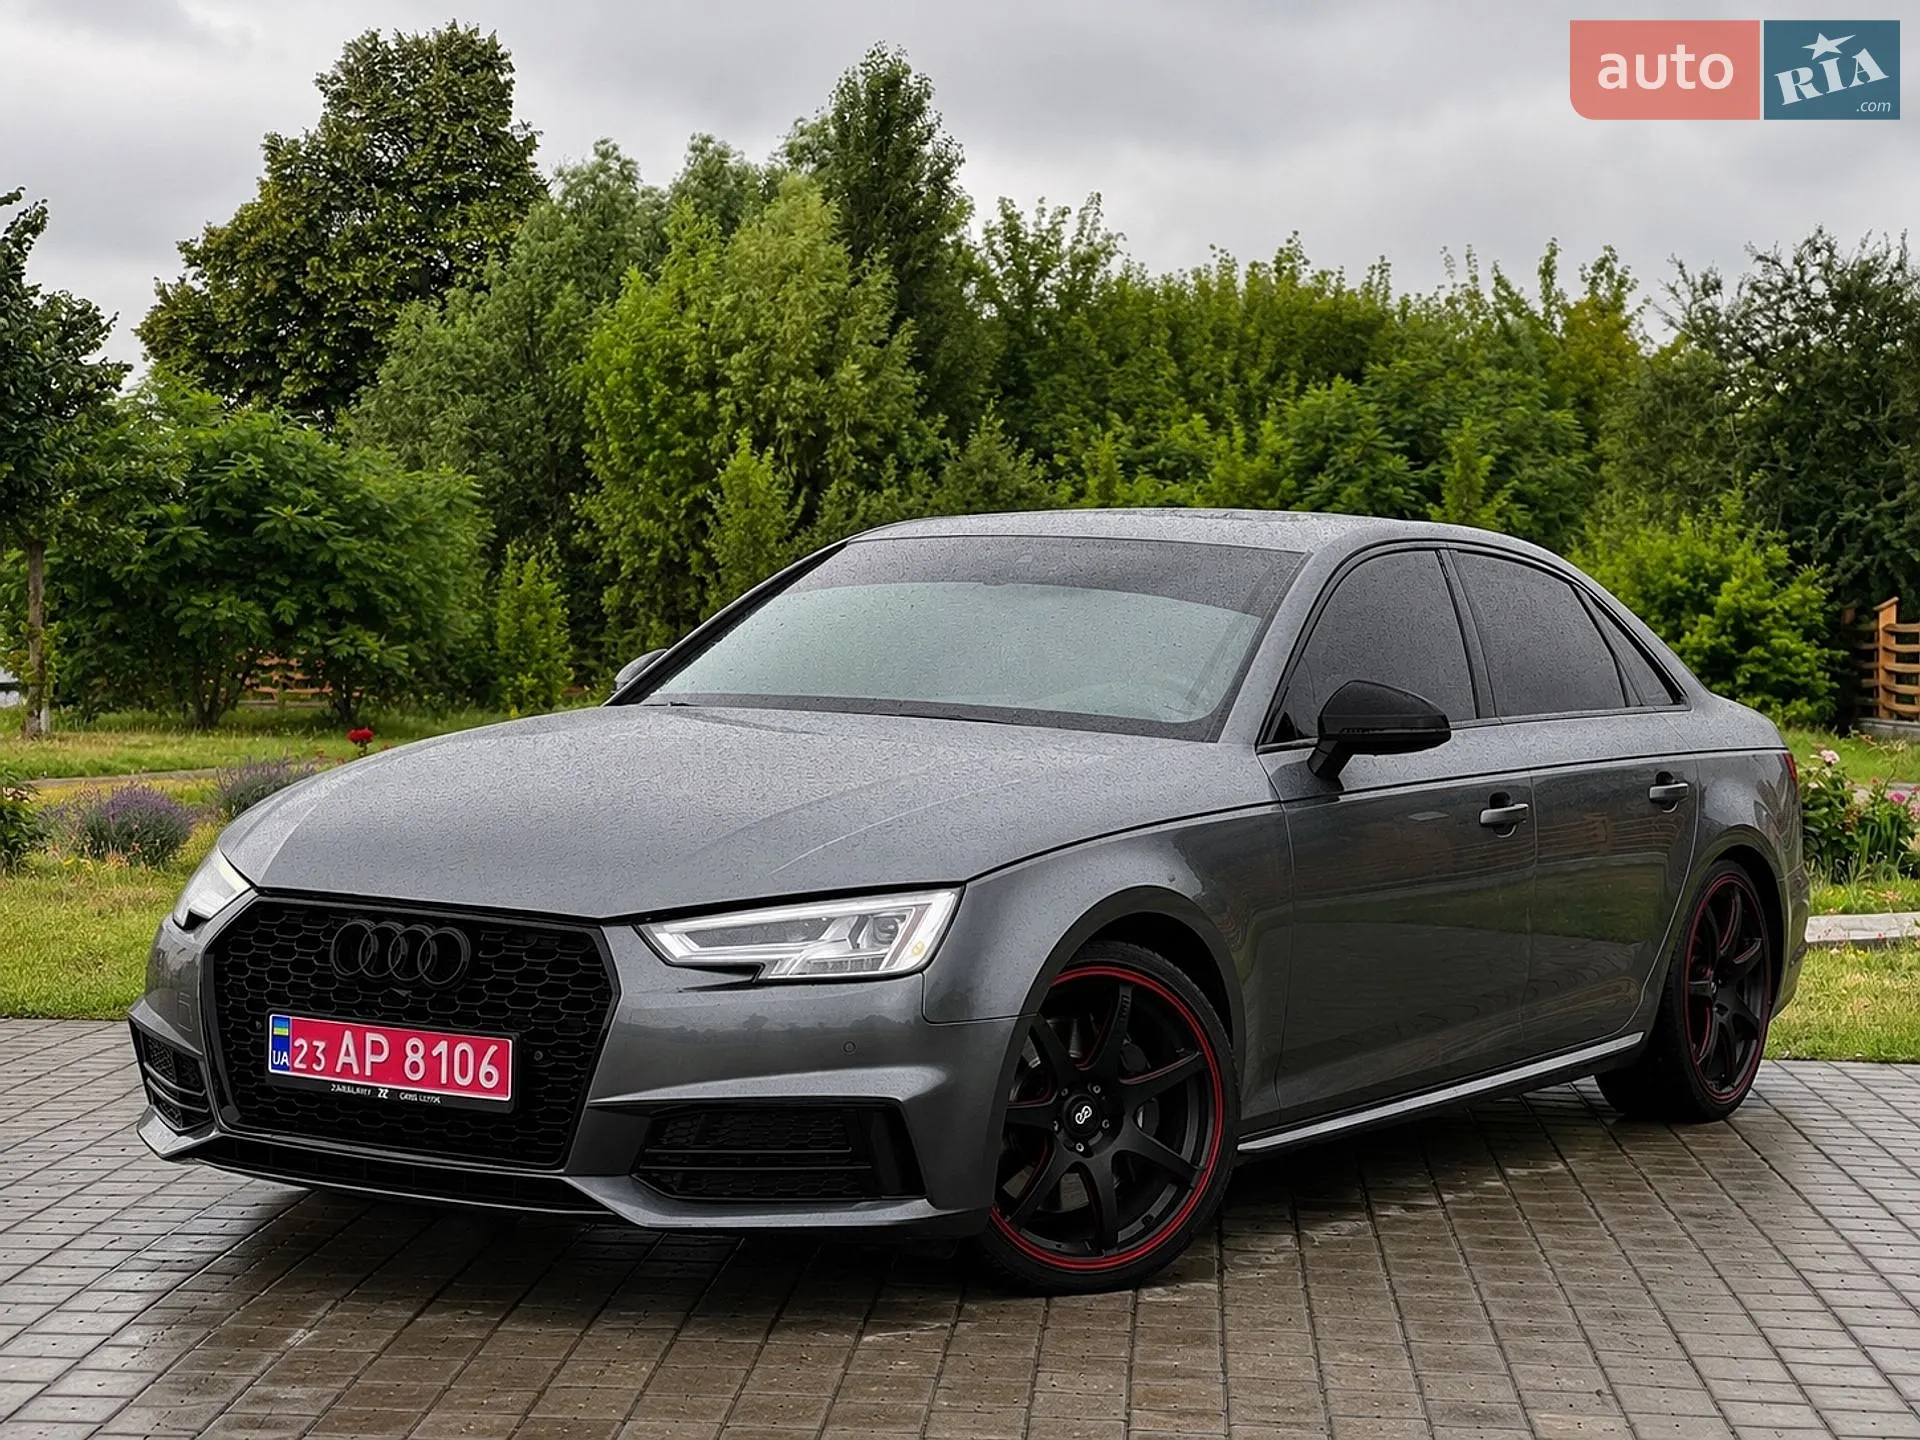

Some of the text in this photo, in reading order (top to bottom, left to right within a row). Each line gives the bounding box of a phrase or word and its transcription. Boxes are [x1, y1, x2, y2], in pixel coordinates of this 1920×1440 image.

[272, 1050, 289, 1067] UA
[293, 1030, 500, 1089] 23 AP 8106
